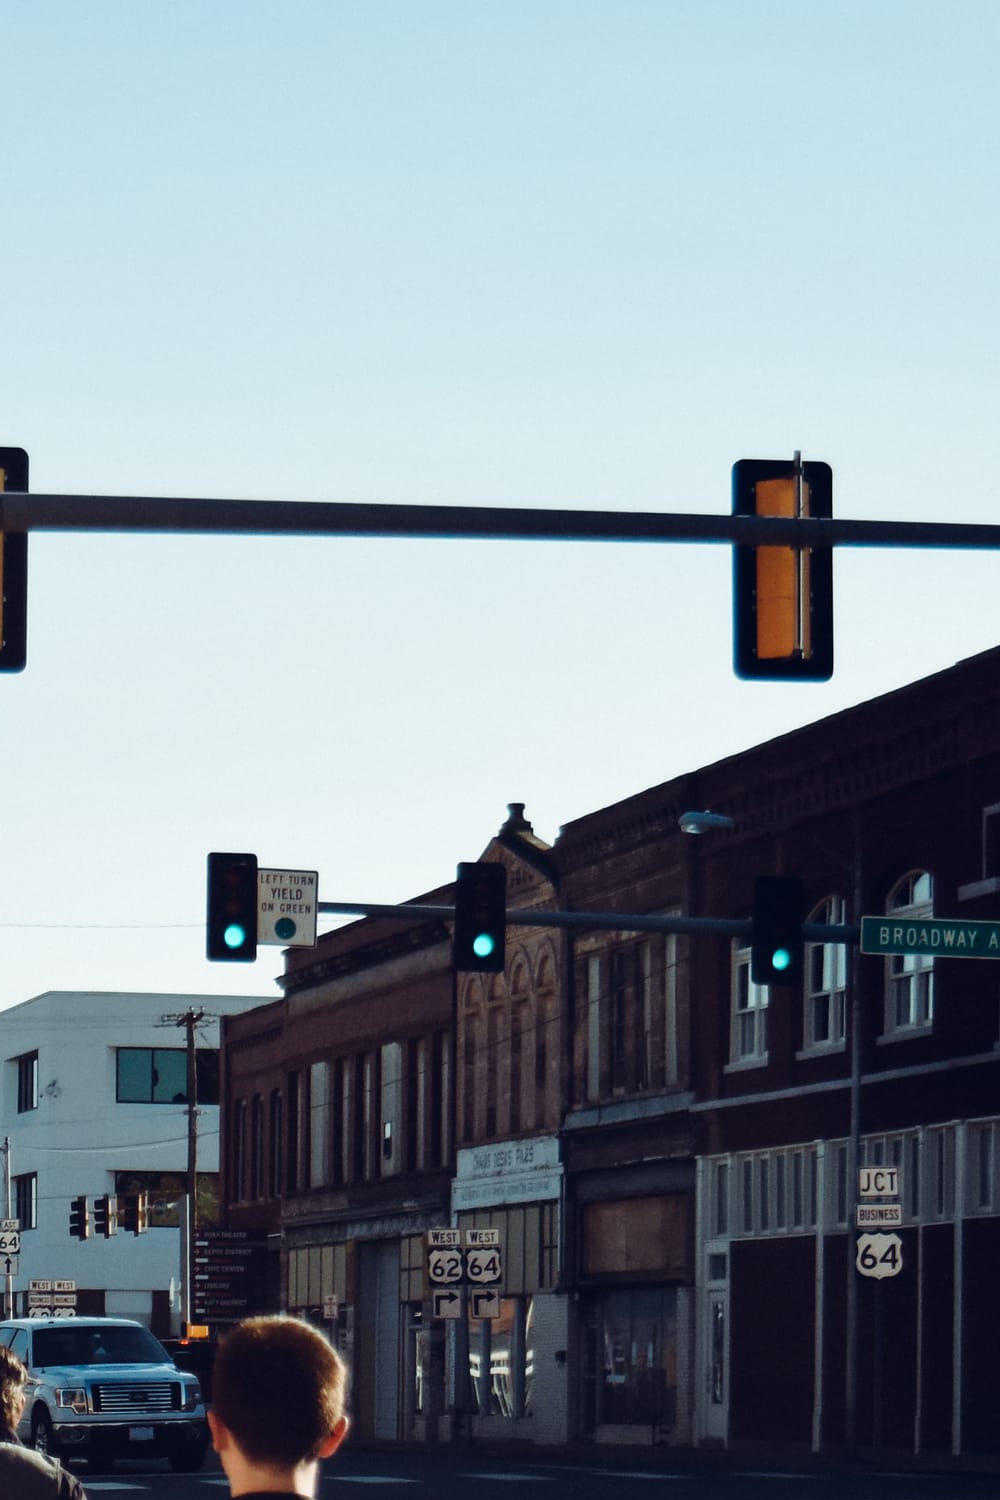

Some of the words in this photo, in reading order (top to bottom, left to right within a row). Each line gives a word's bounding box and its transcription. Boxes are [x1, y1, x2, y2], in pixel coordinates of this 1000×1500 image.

[260, 874, 283, 884] LEFT
[289, 875, 314, 886] TURN
[270, 887, 303, 900] YIELD
[261, 902, 274, 912] ON
[279, 903, 311, 914] GREEN
[879, 926, 977, 948] BROADWAY
[861, 1171, 896, 1192] JCT
[859, 1209, 899, 1221] BUSINESS
[0, 1220, 16, 1228] EAST
[0, 1236, 18, 1249] 64
[432, 1231, 457, 1243] WEST
[470, 1231, 495, 1243] WEST
[860, 1243, 898, 1270] 64
[432, 1258, 459, 1277] 62
[470, 1257, 498, 1276] 64
